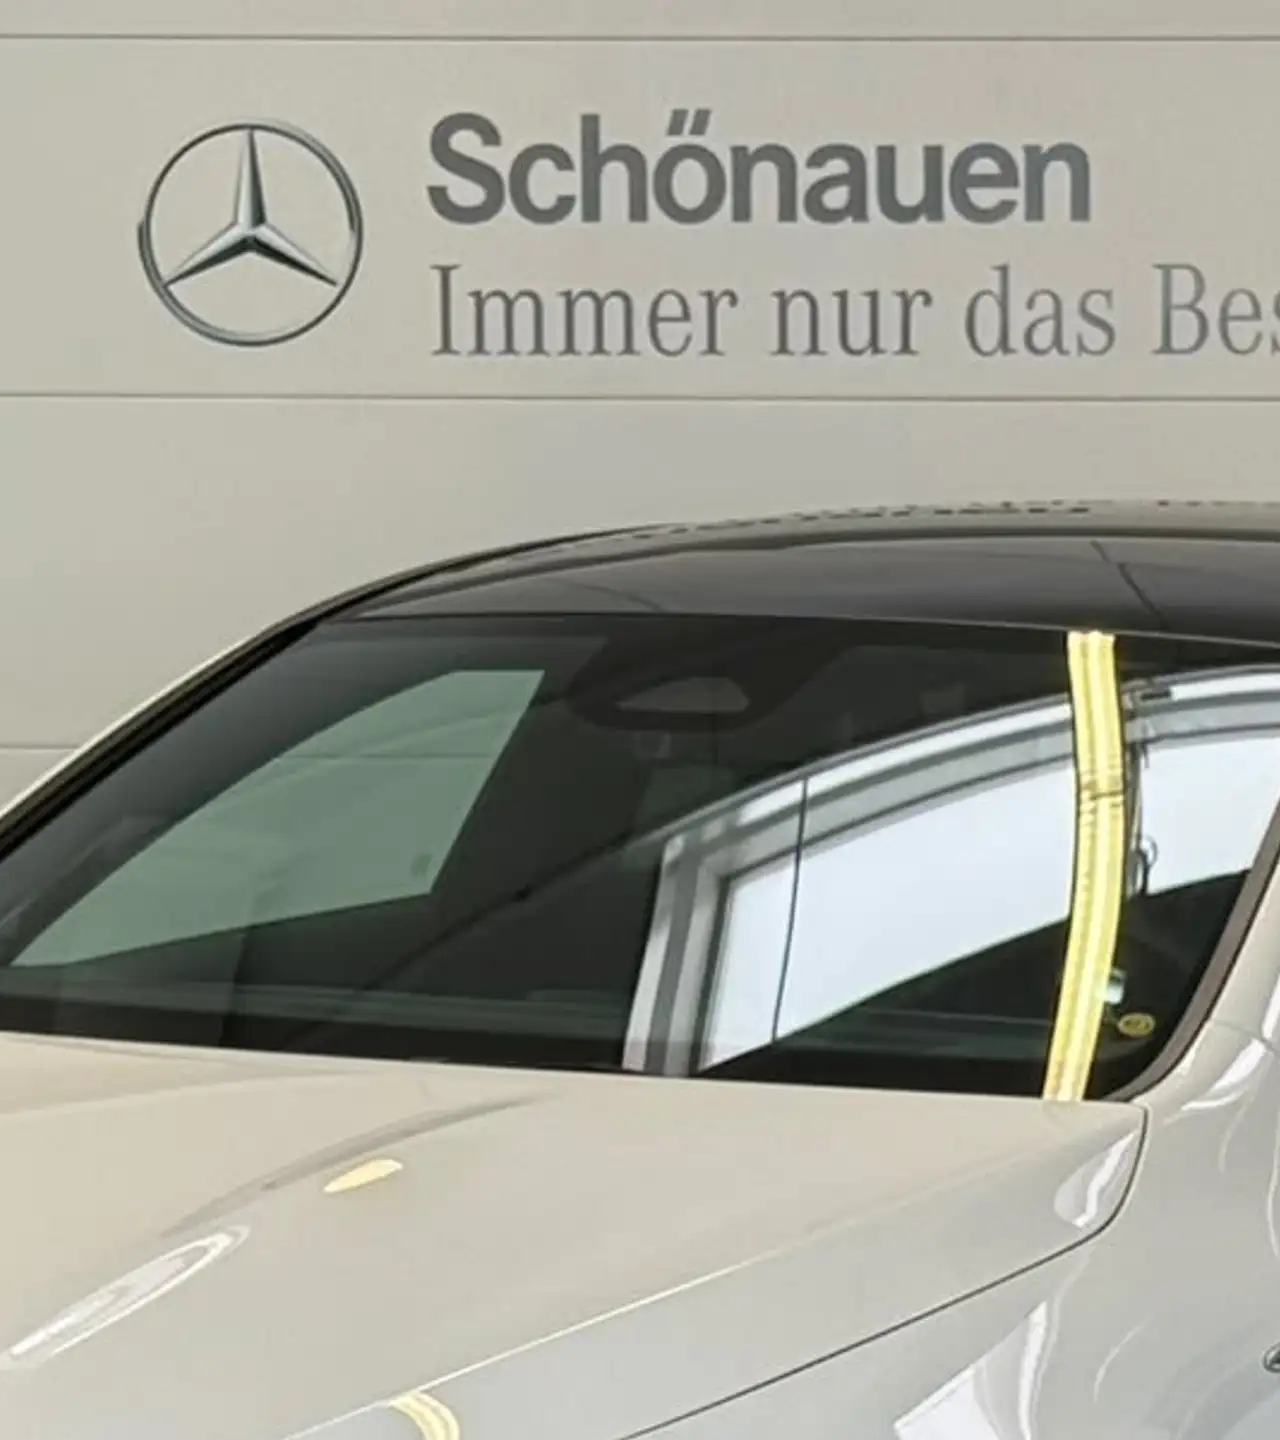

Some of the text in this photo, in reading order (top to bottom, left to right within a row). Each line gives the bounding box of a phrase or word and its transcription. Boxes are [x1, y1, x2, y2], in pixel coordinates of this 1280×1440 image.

[428, 110, 1092, 226] Schönauen
[431, 265, 740, 359] Immer
[771, 289, 935, 358] nur
[965, 264, 1117, 359] das
